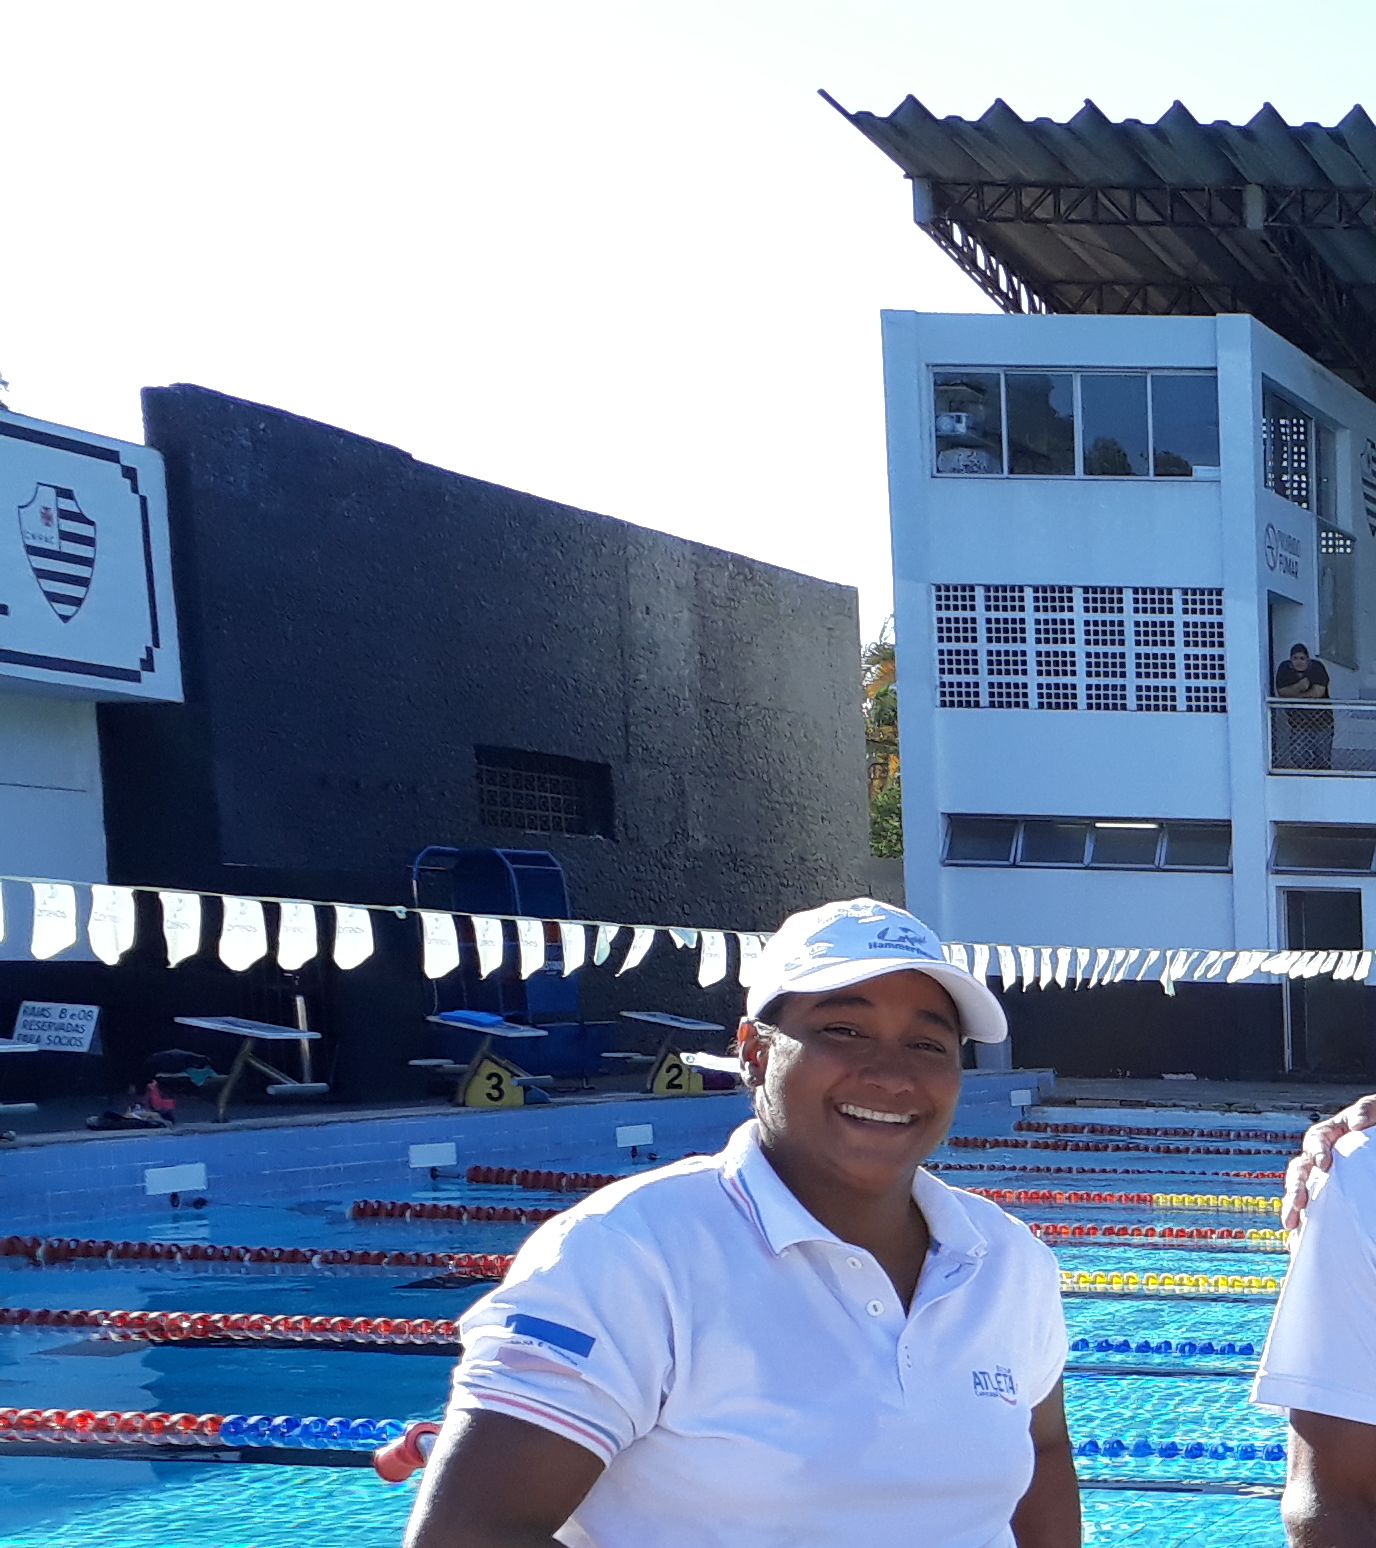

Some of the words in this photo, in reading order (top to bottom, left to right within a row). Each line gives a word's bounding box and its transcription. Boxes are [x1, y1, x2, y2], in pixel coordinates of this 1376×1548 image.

[485, 1071, 505, 1102] 3
[665, 1063, 683, 1090] 2
[972, 1370, 1016, 1396] ATLETA
